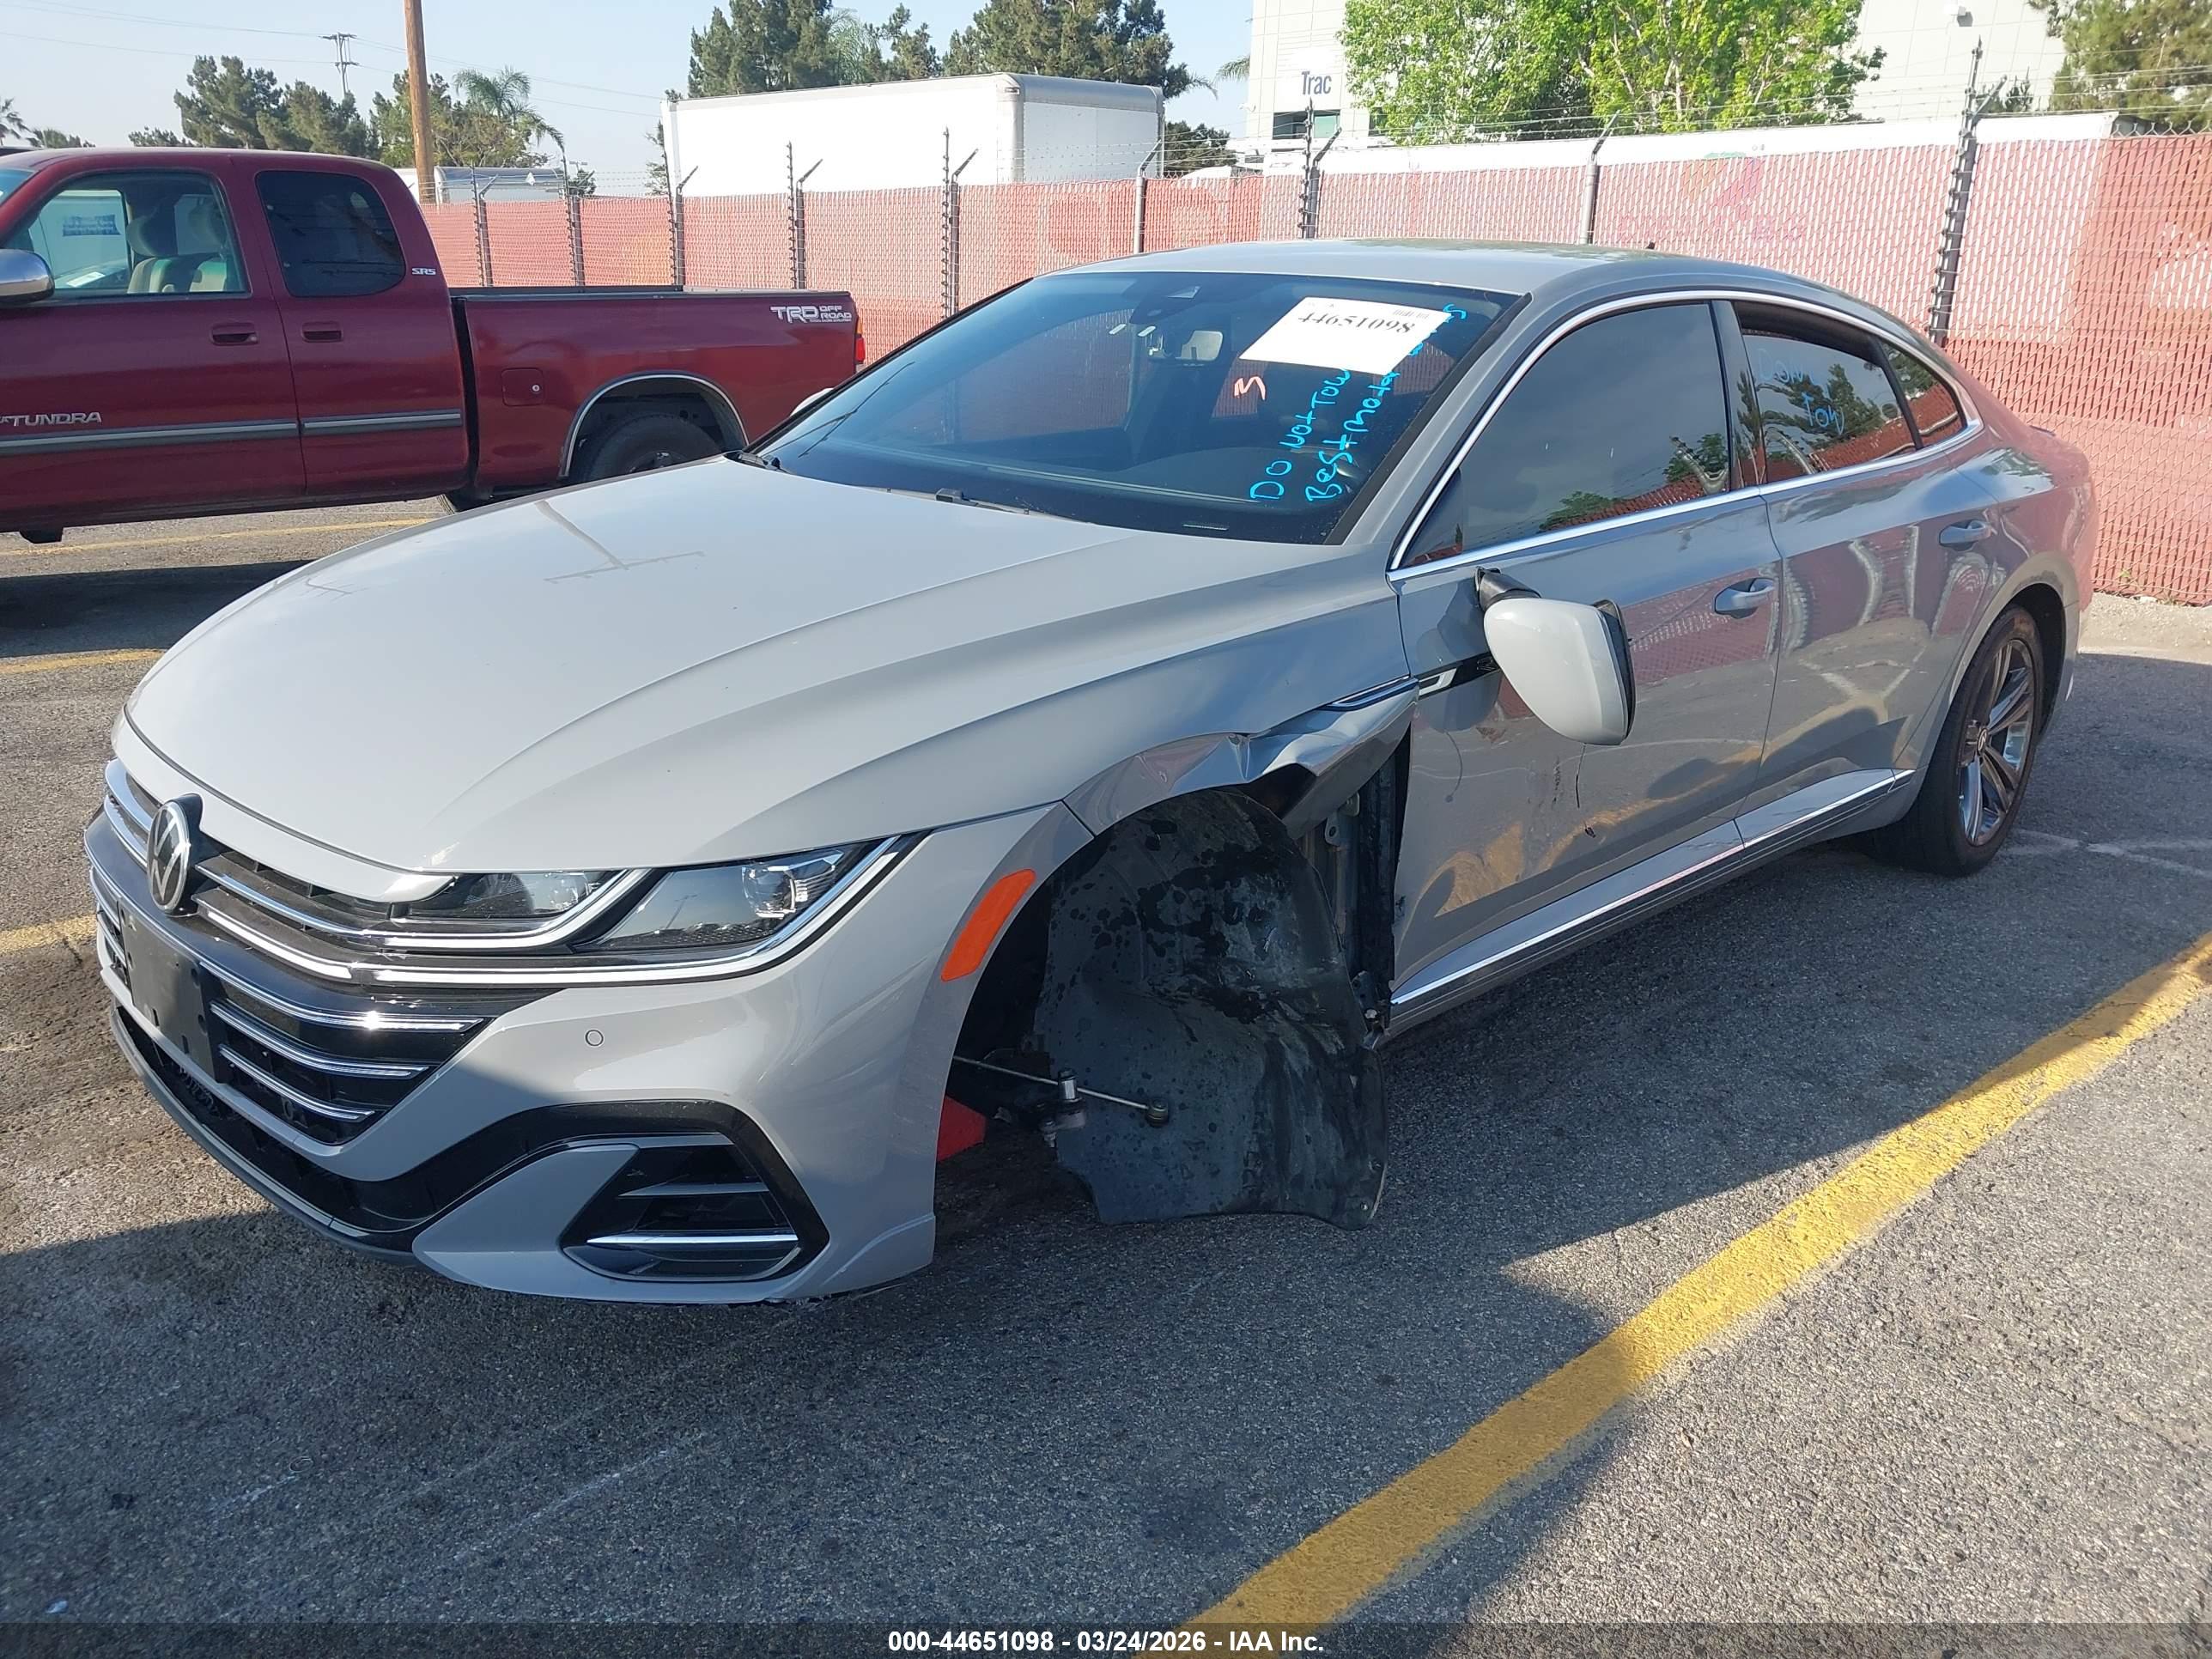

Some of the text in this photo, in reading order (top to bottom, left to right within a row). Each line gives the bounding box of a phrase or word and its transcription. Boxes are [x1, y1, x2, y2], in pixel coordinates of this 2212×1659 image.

[1302, 70, 1332, 94] Trac
[770, 306, 819, 324] TRD
[1298, 312, 1415, 333] 44651098
[11, 411, 102, 427] TUNDRA
